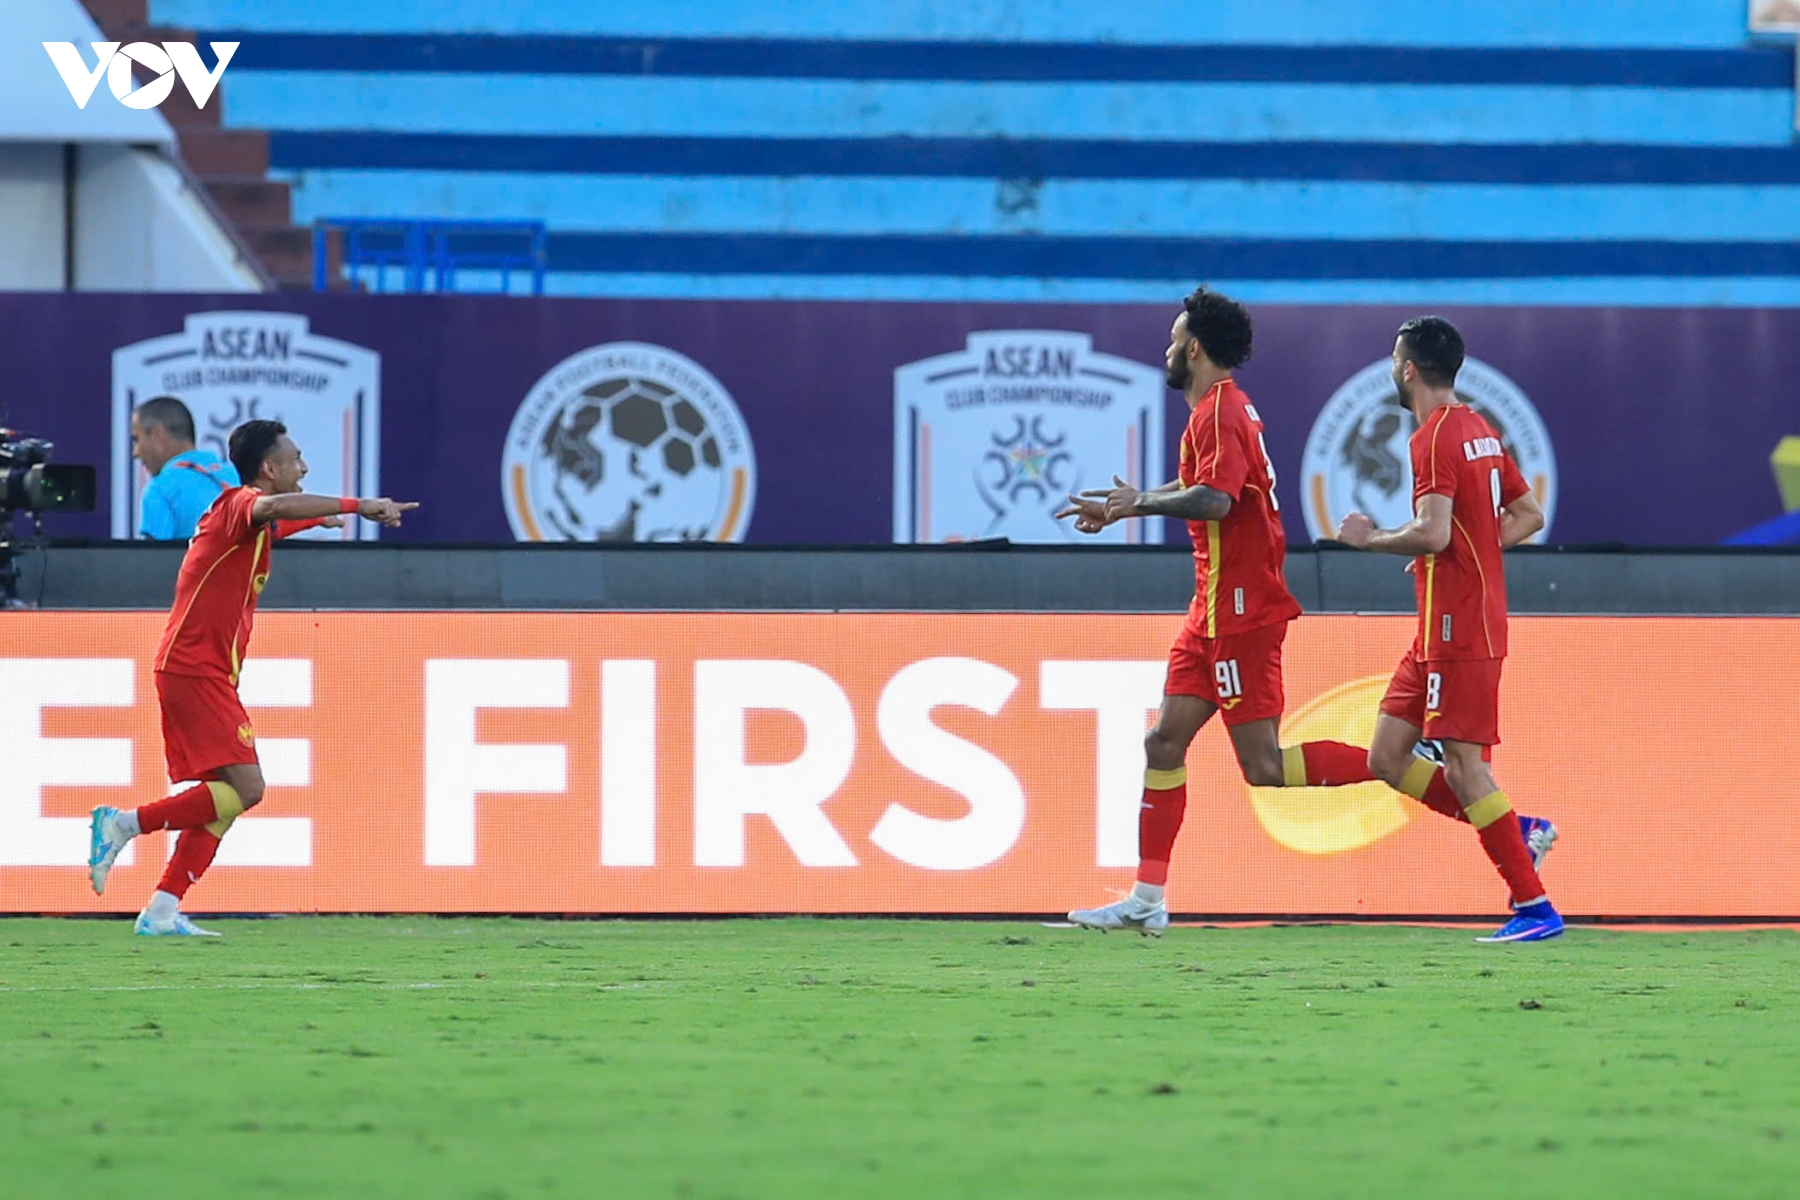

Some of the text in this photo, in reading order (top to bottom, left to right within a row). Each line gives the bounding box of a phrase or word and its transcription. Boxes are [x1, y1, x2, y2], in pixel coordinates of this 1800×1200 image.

[202, 329, 292, 359] ASEAN
[983, 347, 1074, 378] ASEAN
[163, 366, 329, 393] CLUB CHAMPIONSHIP
[945, 384, 1113, 410] CLUB CHAMPIONSHIP
[1215, 659, 1242, 698] 91
[1426, 672, 1442, 709] 8
[424, 656, 1170, 871] FIRST
